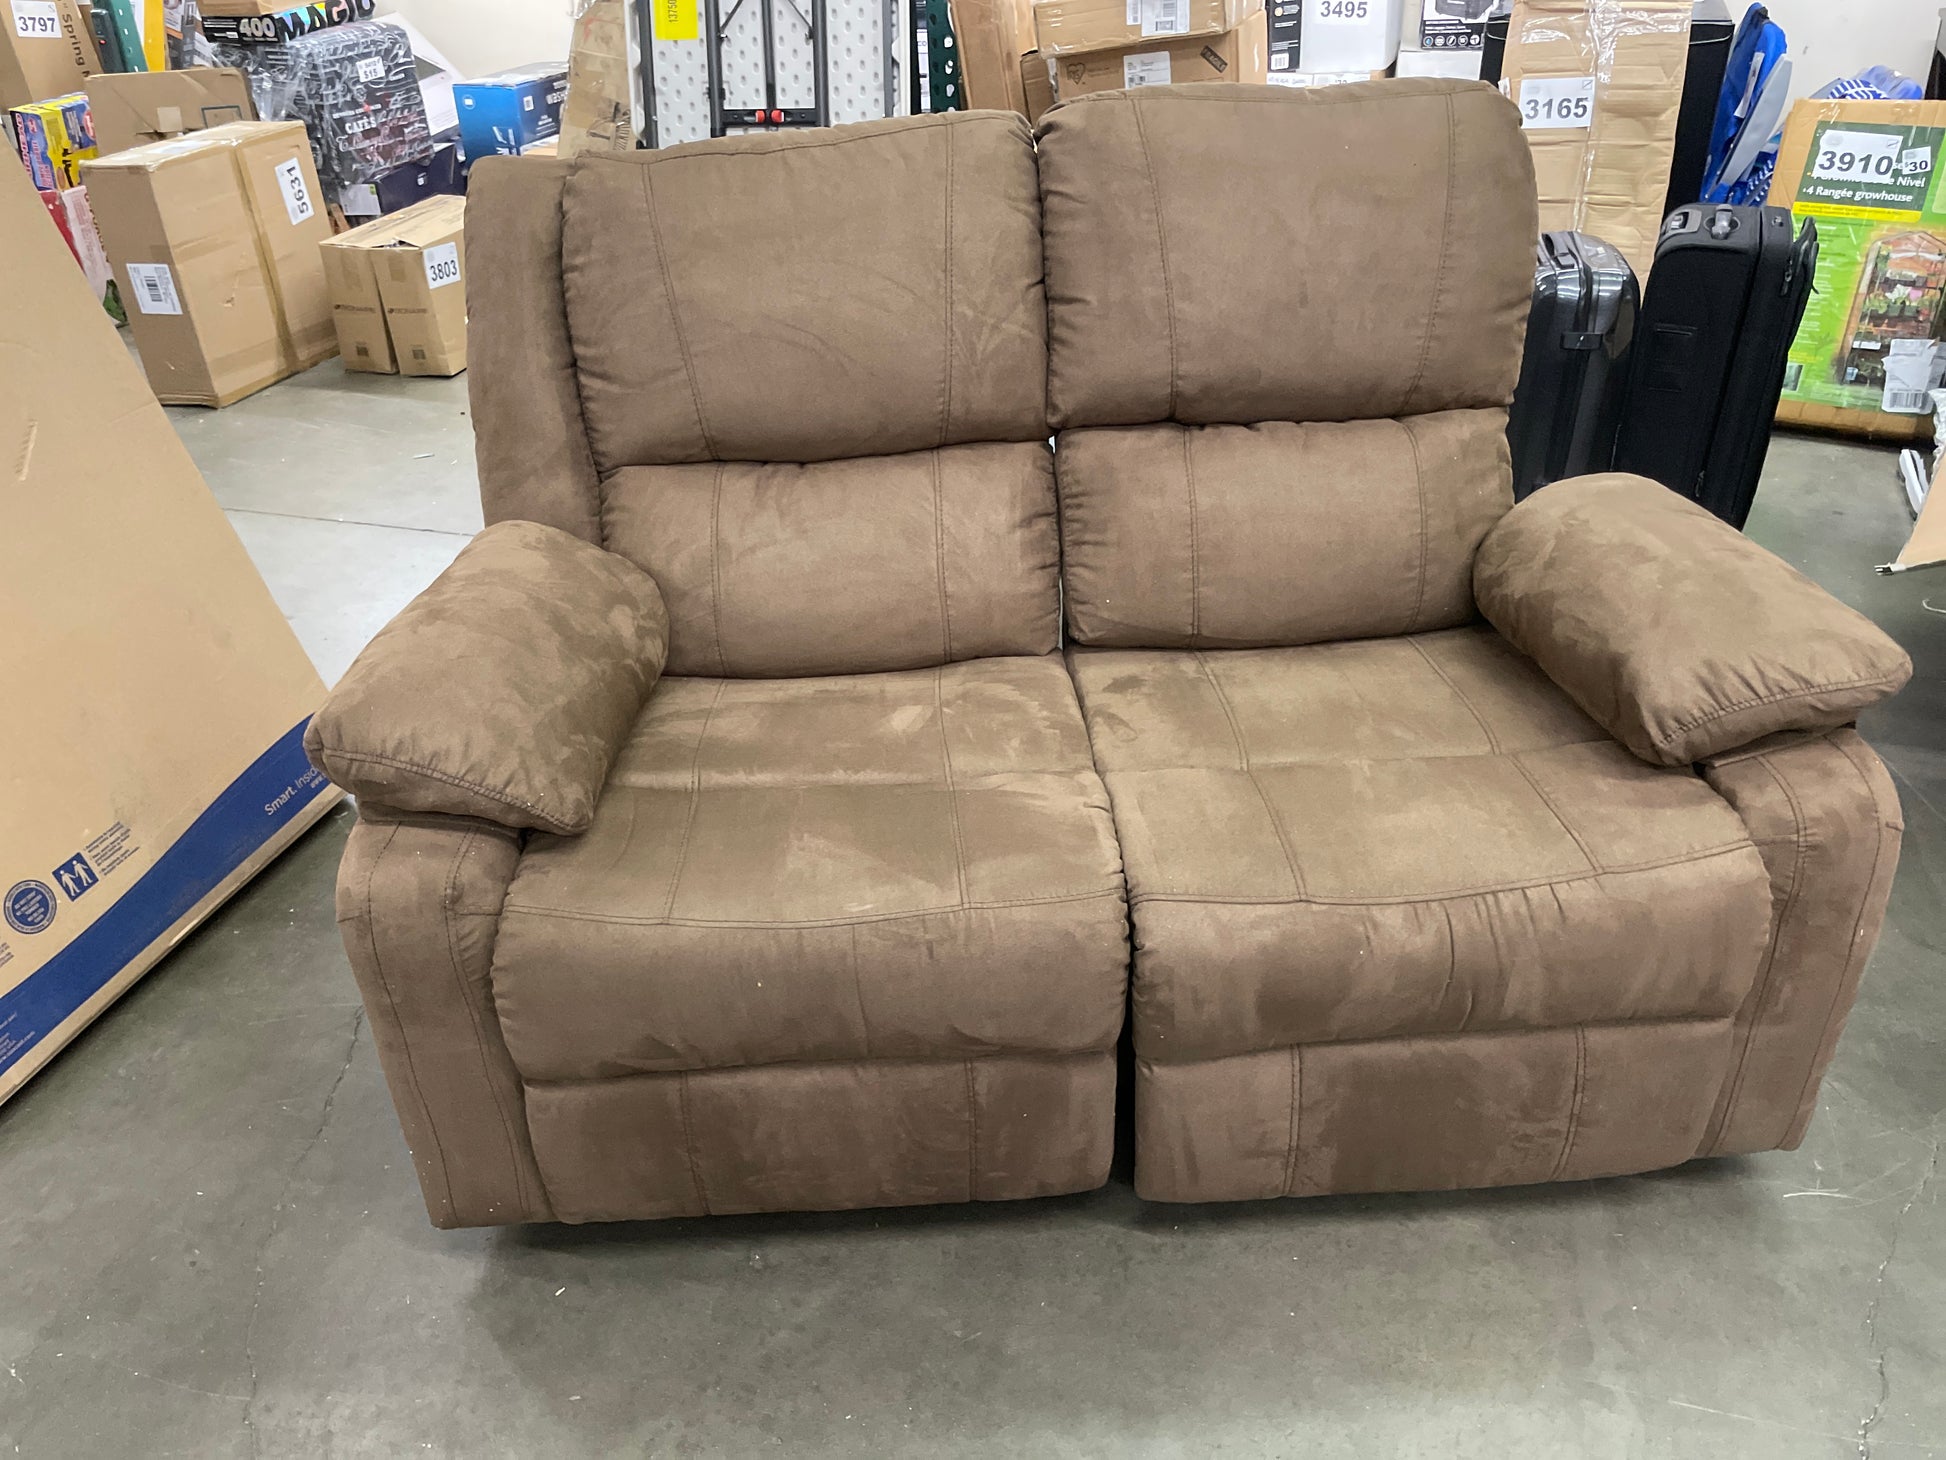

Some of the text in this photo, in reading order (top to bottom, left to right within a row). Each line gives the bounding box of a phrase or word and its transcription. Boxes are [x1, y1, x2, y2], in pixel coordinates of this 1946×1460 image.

[1320, 0, 1368, 18] 3495
[18, 16, 56, 32] 3797
[239, 18, 276, 38] 400
[62, 14, 85, 66] Spring
[1524, 97, 1588, 120] 3165
[1818, 150, 1893, 176] 3910
[1904, 160, 1928, 172] $30
[286, 166, 308, 214] 5631
[1896, 176, 1926, 188] Nivel
[1816, 187, 1853, 200] Rangée
[1854, 190, 1914, 202] growhouse
[430, 260, 458, 282] 3803
[264, 786, 298, 816] Smart.
[296, 764, 319, 790] Insid
